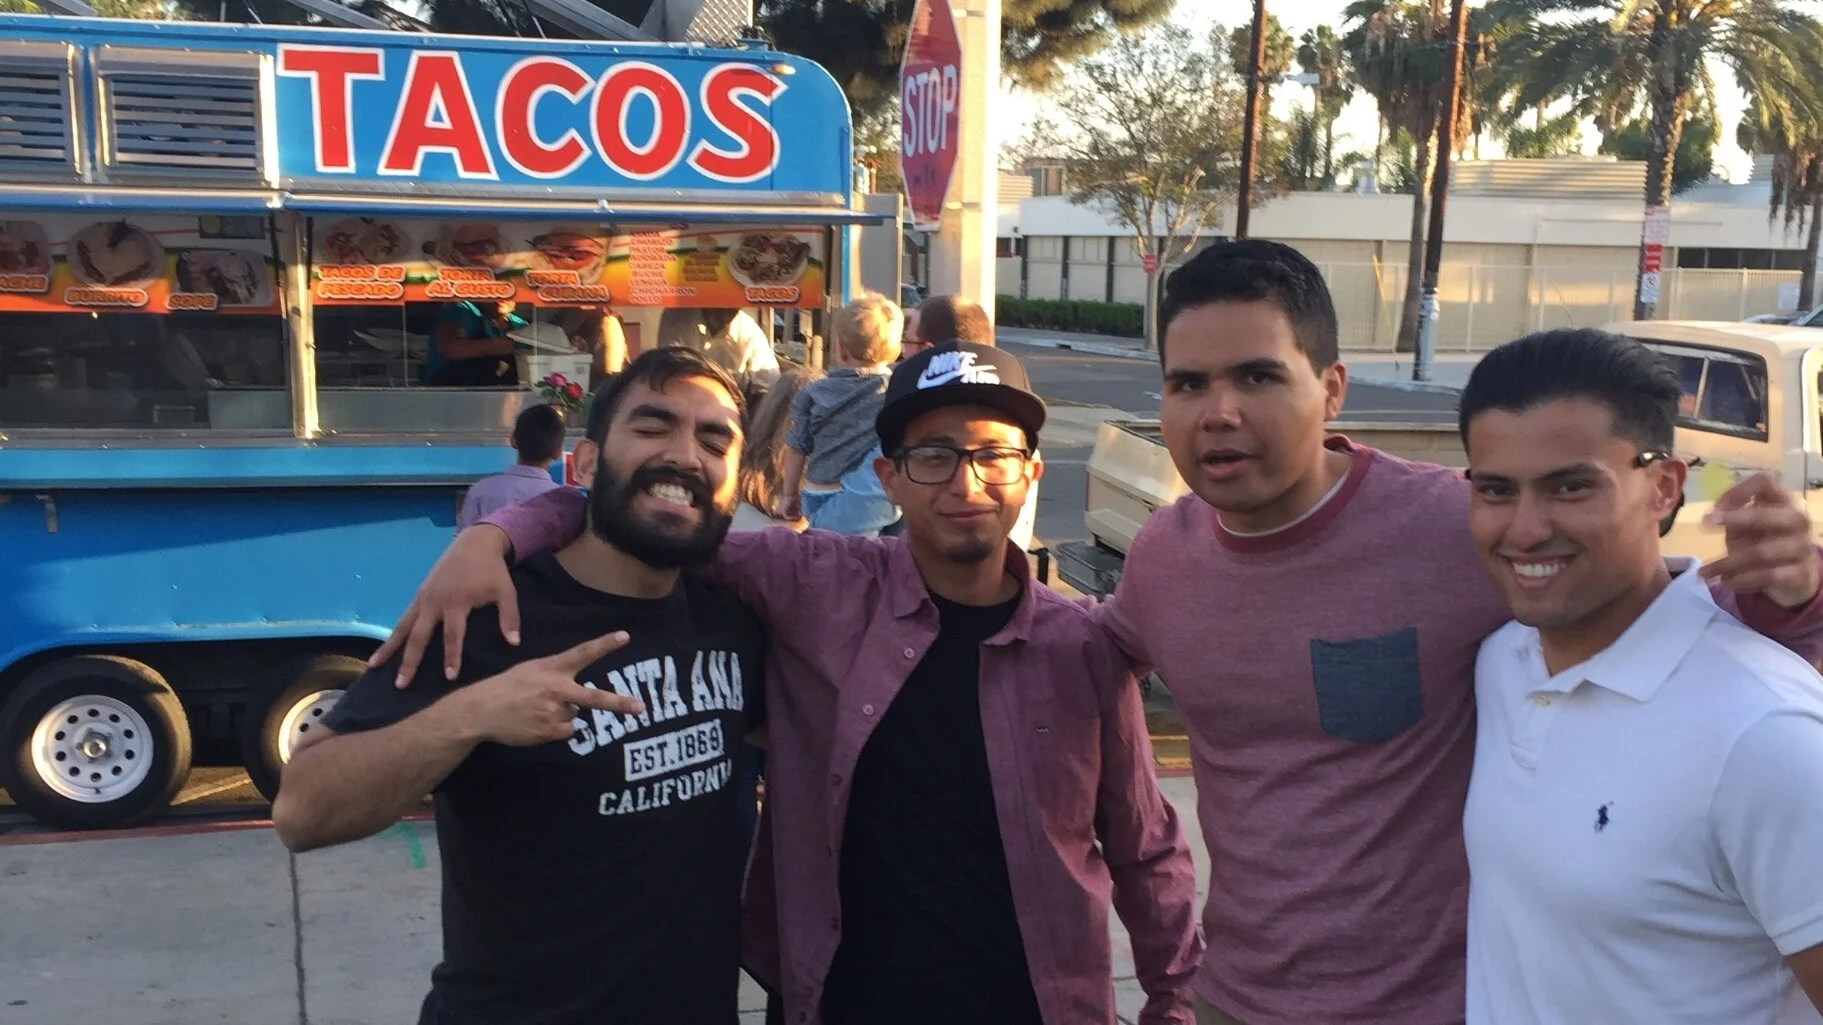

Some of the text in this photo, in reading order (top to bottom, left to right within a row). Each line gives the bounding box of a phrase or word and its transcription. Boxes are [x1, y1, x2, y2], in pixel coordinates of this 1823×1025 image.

[276, 44, 788, 183] TACOS
[903, 64, 957, 158] STOP
[320, 266, 404, 280] TACOS DE
[526, 271, 579, 285] TORTA
[67, 290, 146, 304] BURRITO
[320, 282, 402, 297] PESCADO
[427, 282, 513, 297] AL GUSTO
[926, 351, 978, 378] NIKE
[691, 650, 744, 712] ANA
